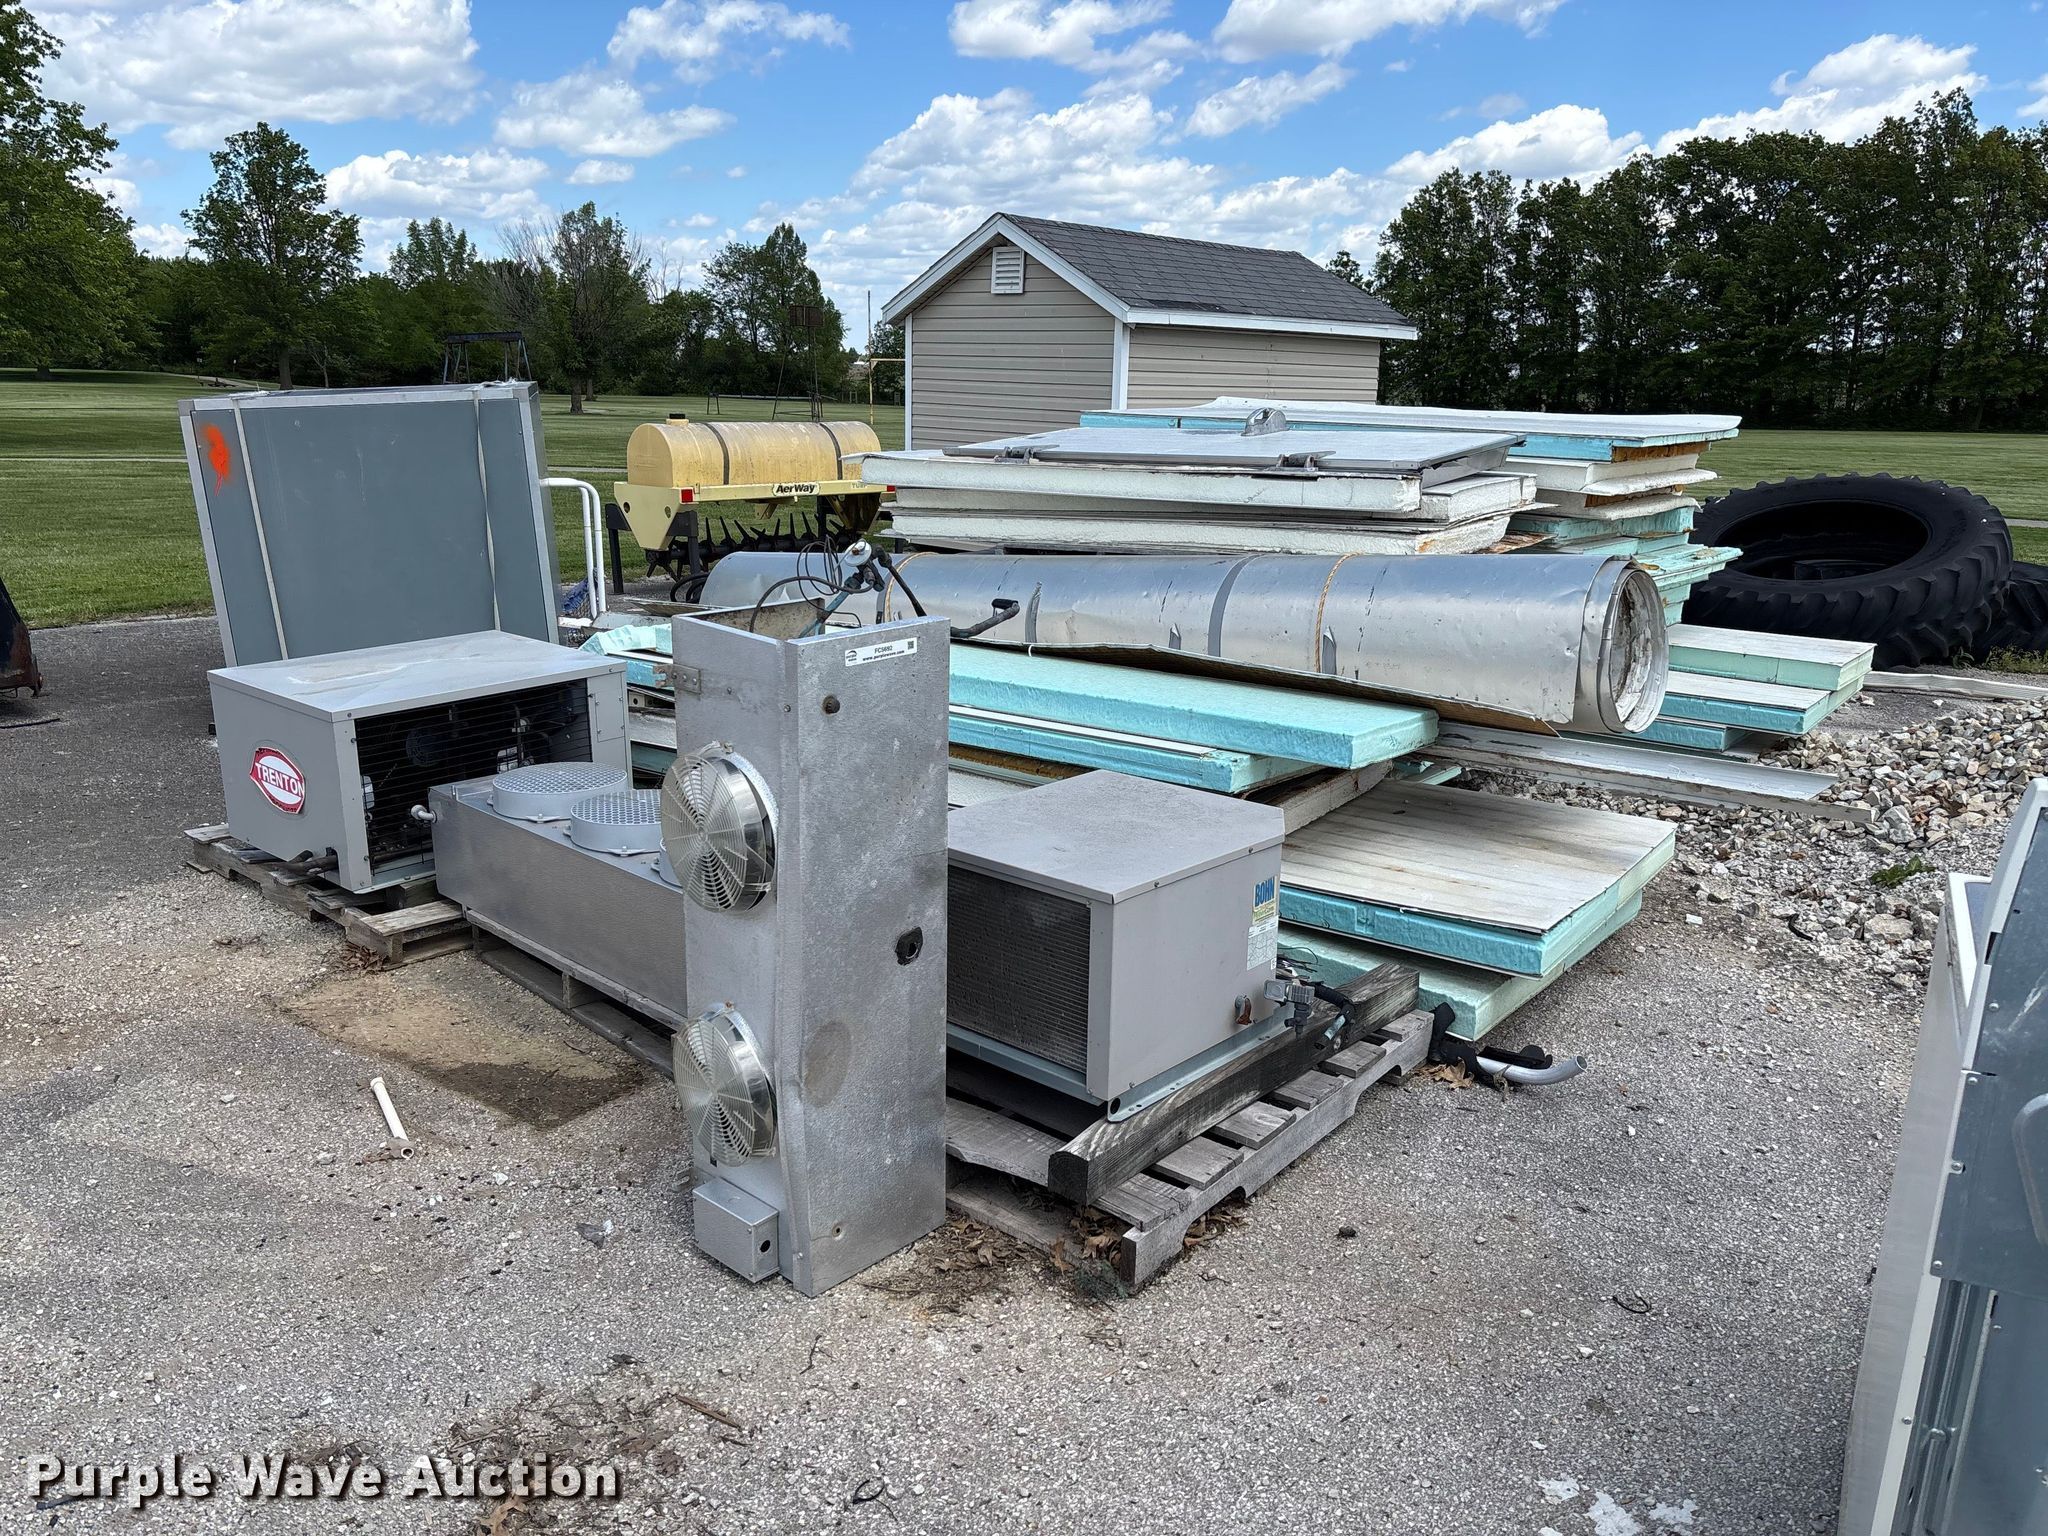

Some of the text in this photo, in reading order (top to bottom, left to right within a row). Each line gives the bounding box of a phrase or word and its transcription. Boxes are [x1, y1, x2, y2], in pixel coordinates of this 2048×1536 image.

[776, 483, 816, 494] AerWay
[255, 762, 304, 797] TRENTON
[1254, 876, 1275, 908] BOHN
